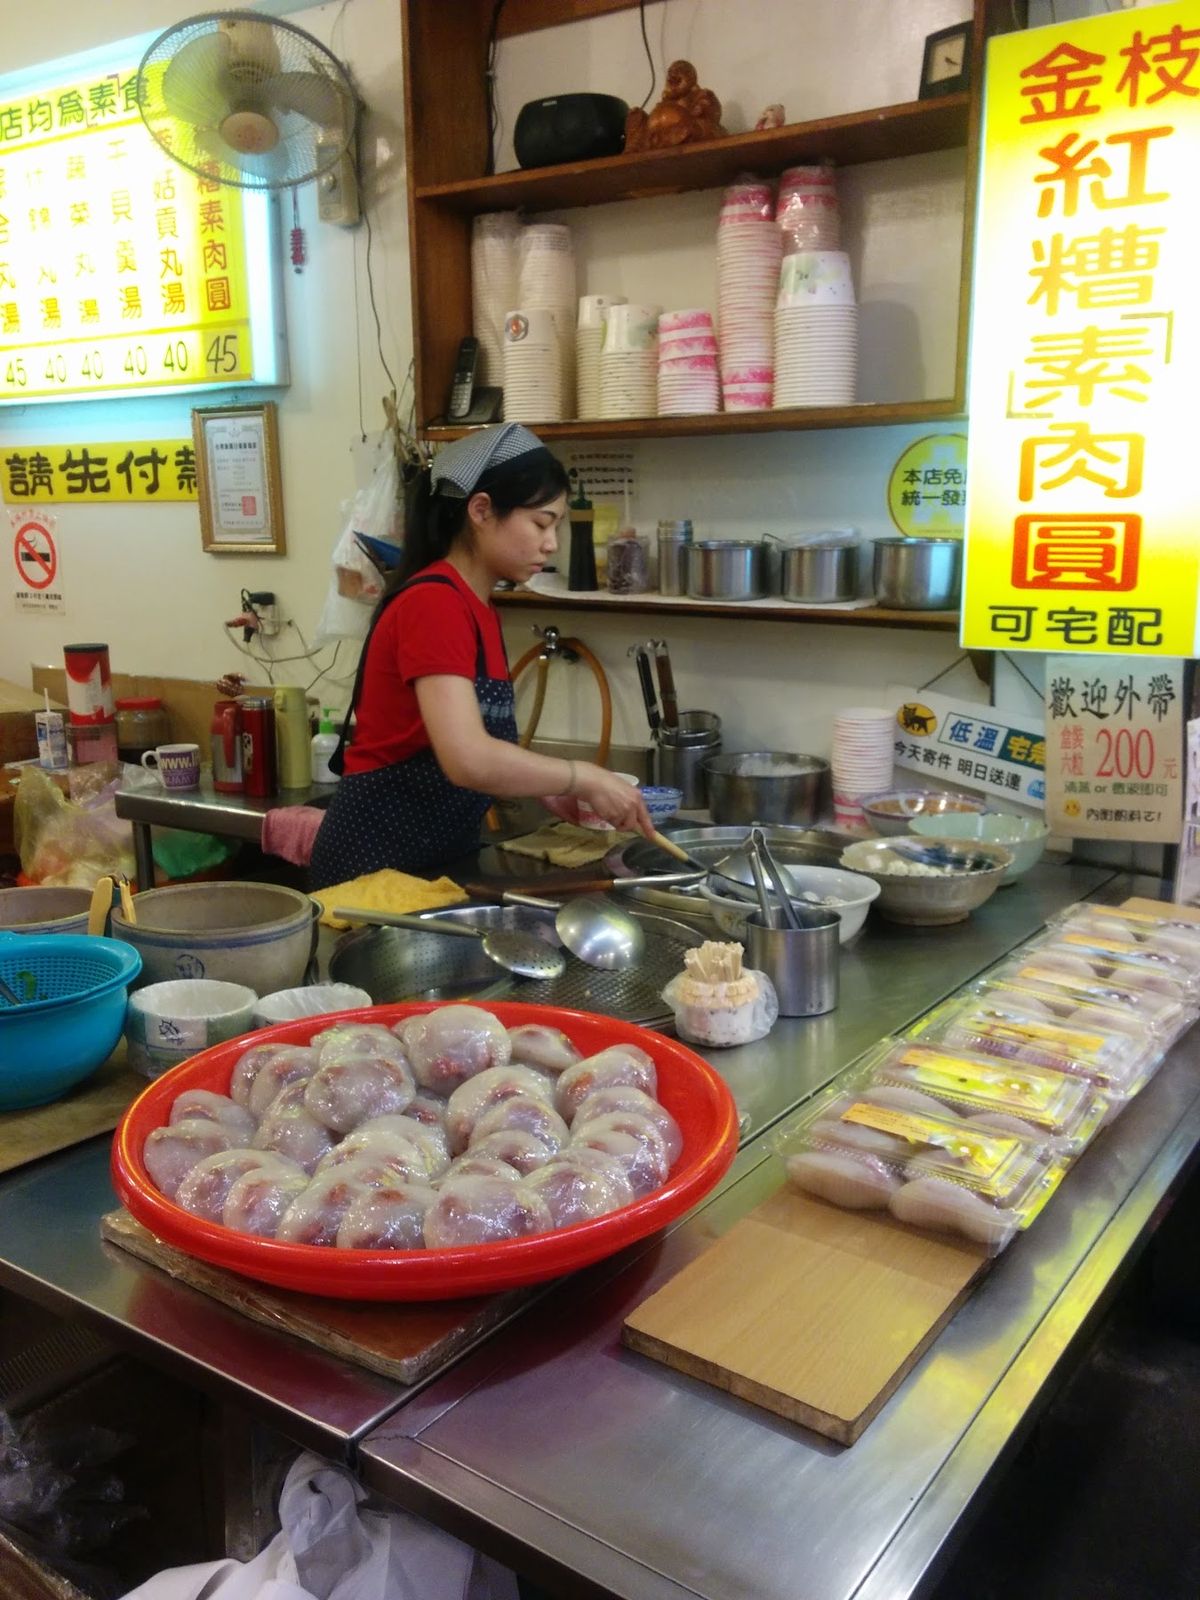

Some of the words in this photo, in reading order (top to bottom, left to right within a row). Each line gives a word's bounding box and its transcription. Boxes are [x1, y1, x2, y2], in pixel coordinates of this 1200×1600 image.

[1019, 25, 1200, 124] 金枝
[46, 355, 67, 383] 40
[82, 351, 104, 380] 40
[124, 345, 148, 377] 40
[163, 340, 189, 373] 40
[206, 334, 238, 374] 45
[6, 358, 27, 387] 45
[902, 467, 967, 486] 本店免
[901, 489, 966, 507] 統一發
[988, 605, 1163, 647] 可宅配
[1049, 673, 1176, 723] 歡迎外帶
[948, 719, 1000, 752] 低溫
[894, 741, 952, 771] 今天寄件
[957, 758, 1023, 792] 明日送達
[1095, 728, 1156, 780] 200
[1162, 757, 1178, 780] 元
[1094, 785, 1109, 794] or
